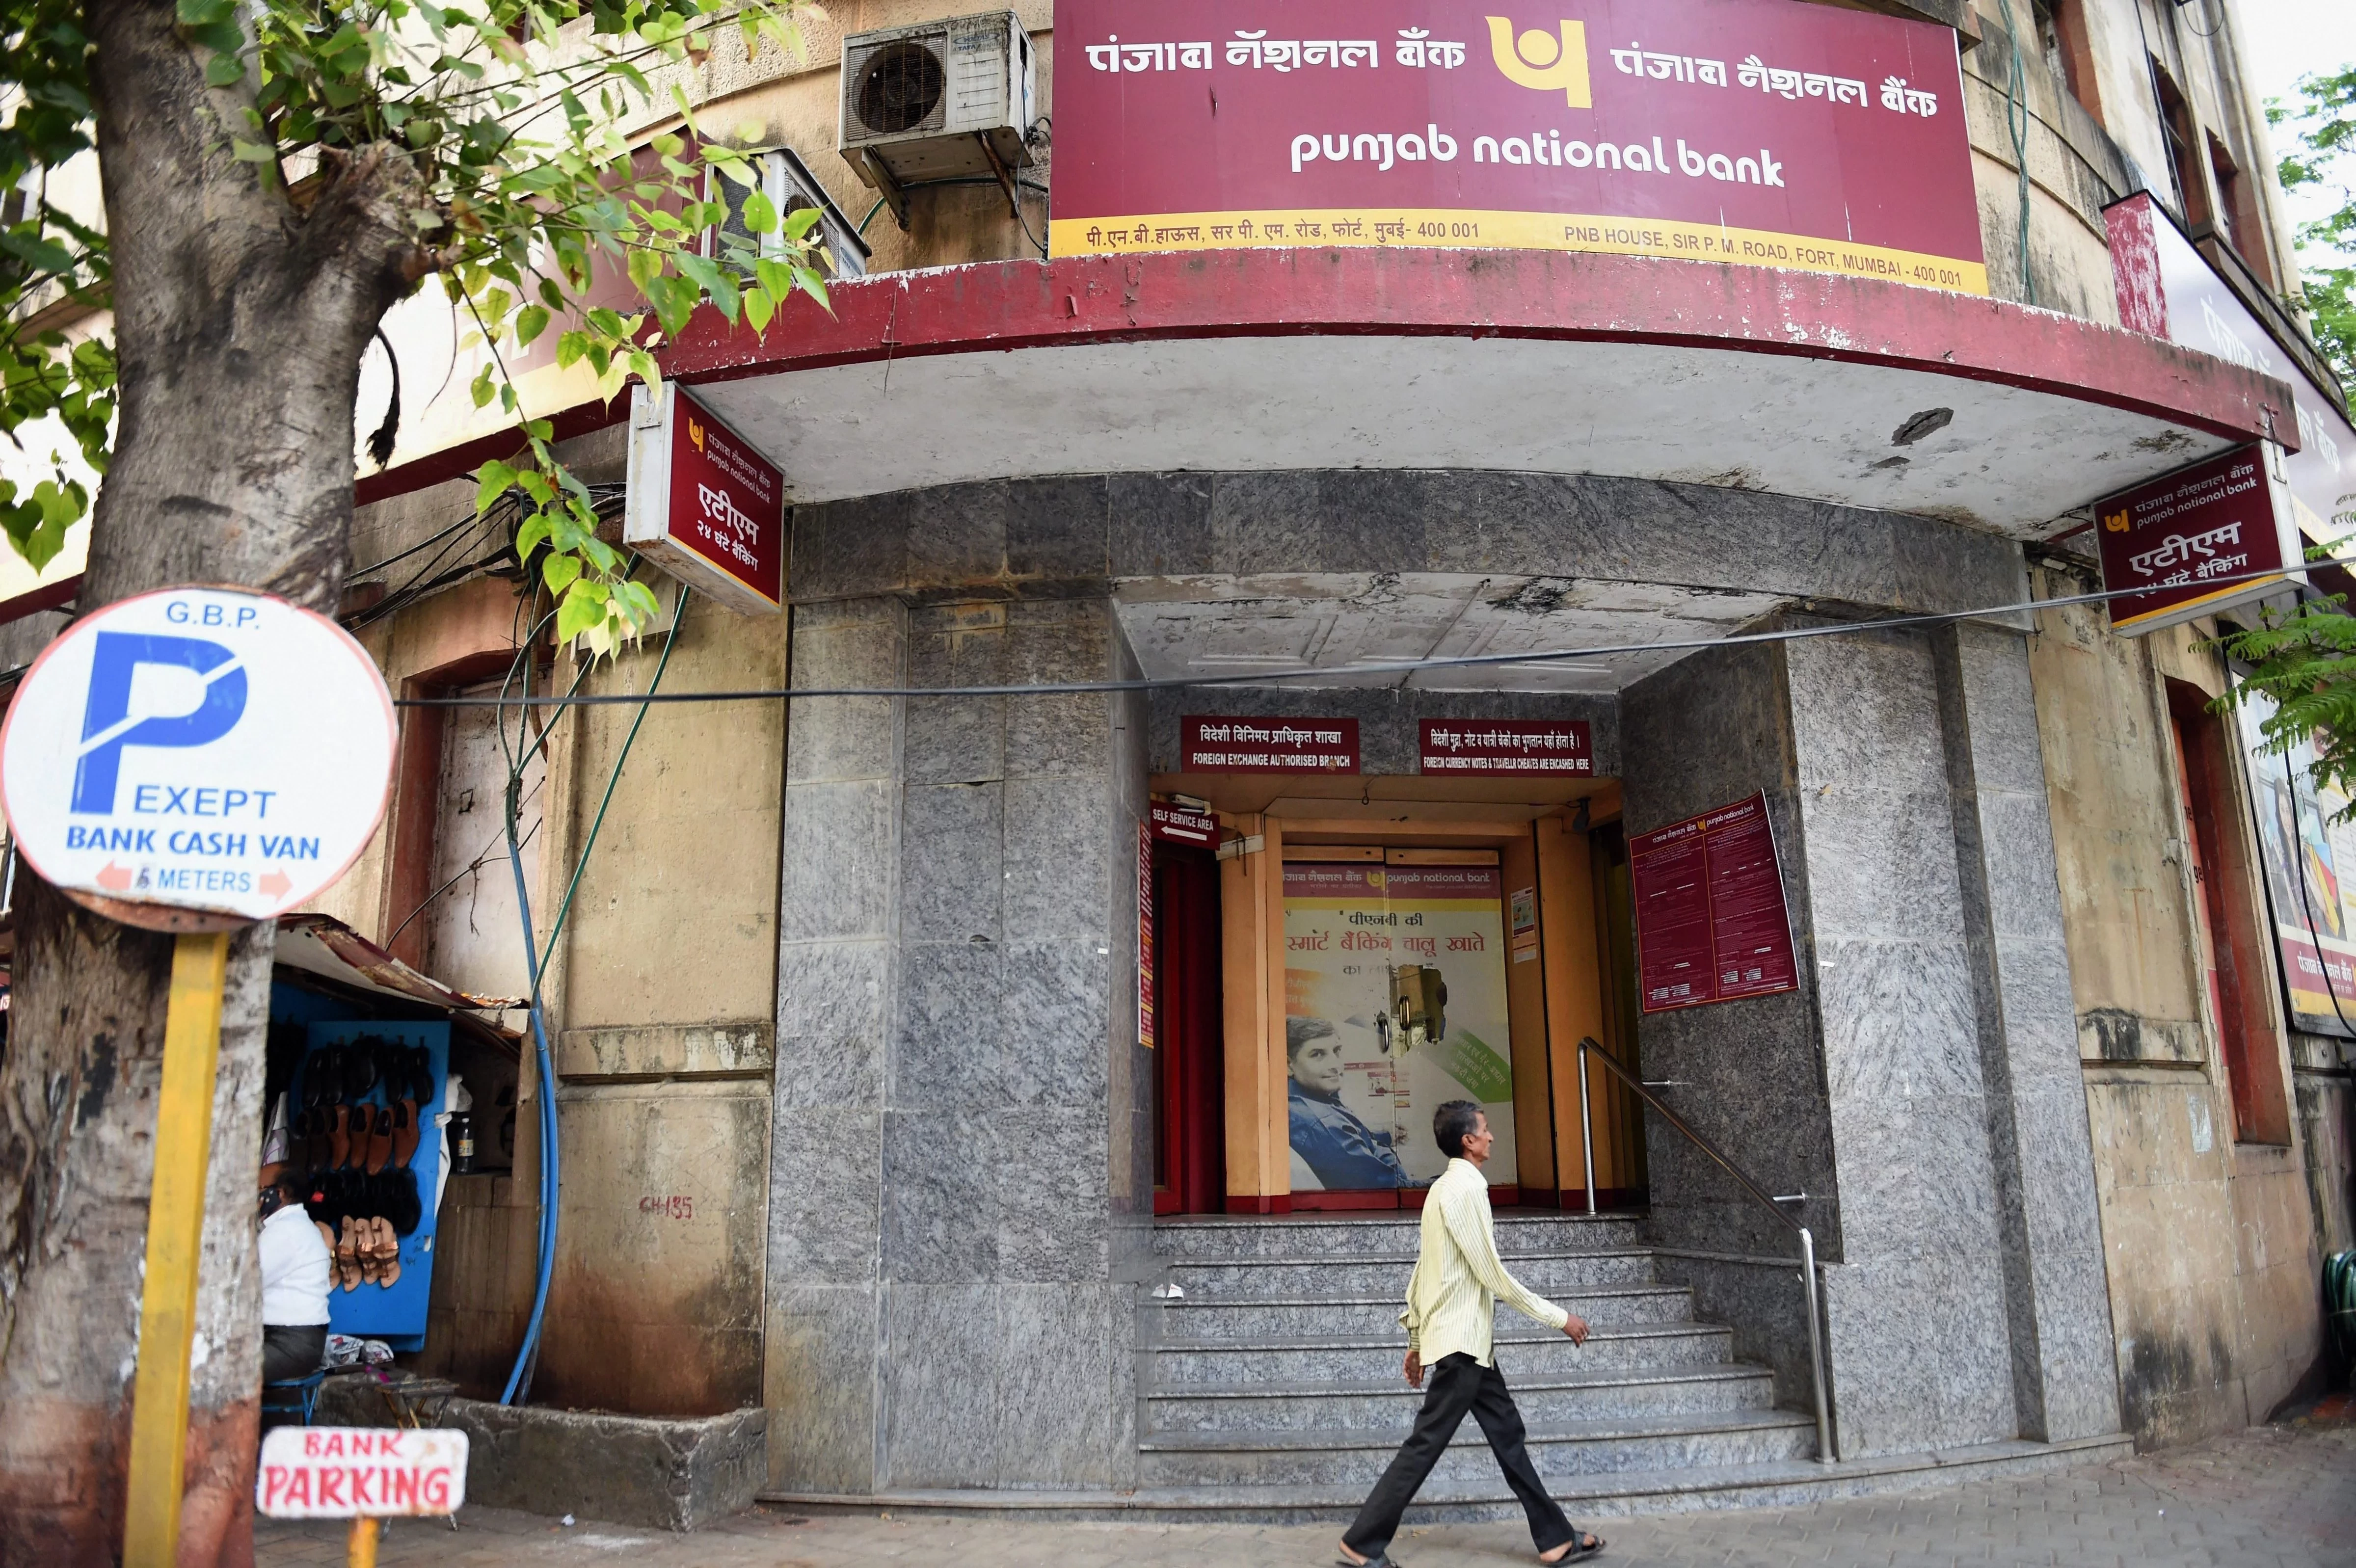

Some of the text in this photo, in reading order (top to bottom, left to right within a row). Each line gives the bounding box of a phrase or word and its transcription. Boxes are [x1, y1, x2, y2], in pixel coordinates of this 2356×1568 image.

[1086, 34, 1212, 72] पंजाब
[1226, 29, 1378, 72] नॅशनल
[1610, 41, 1937, 118] पंजाब नैशनल बैंक
[1291, 124, 1784, 188] punjab national bank
[1210, 225, 1232, 240] सर
[1264, 224, 1289, 240] एम.
[1295, 218, 1326, 239] रोड,
[1332, 218, 1367, 239] फोर्ट,
[1418, 222, 1446, 238] 400
[1452, 223, 1478, 238] 001
[1564, 226, 1600, 242] PNB
[1605, 228, 1668, 249] HOUSE,
[1673, 233, 1700, 250] SIR
[1704, 237, 1717, 252] P.
[1721, 238, 1739, 254] M.
[1743, 241, 1793, 263] ROAD,
[1796, 247, 1839, 270] FORT,
[1843, 254, 1901, 276] MUMBAI
[1914, 265, 1935, 282] 400
[1939, 269, 1961, 287] 001
[708, 433, 730, 458] पंजाब
[707, 450, 770, 504] punjab national bank
[2135, 464, 2254, 513] पंजाब नैशनल बैंक
[698, 482, 759, 545] एटीएम
[2137, 477, 2257, 530] punjab national bank
[697, 520, 758, 571] २४ घंटे बैंकिंग
[2129, 521, 2242, 577] एटीएम
[2195, 553, 2248, 579] बैंकिंग
[166, 601, 261, 630] G.B.P.
[70, 631, 248, 816] P
[1200, 724, 1341, 748] विदेशी विनिमय प्राधिकृत शाखा
[1431, 728, 1448, 746] विदेशी
[1464, 729, 1475, 747] नोट
[1476, 734, 1482, 747] व
[1482, 729, 1497, 747] यात्री
[1498, 729, 1511, 747] चेकों
[1512, 735, 1521, 747] का
[1522, 735, 1542, 753] भुगतान
[1543, 729, 1554, 749] यहाँ
[1555, 730, 1569, 749] होता
[1193, 752, 1350, 767] FOREIGN EXCHANGE AUTHORISED BRANCH
[1423, 756, 1445, 768] FOREIGN
[1446, 757, 1471, 769] CURRENCY
[1472, 757, 1487, 769] NOTES
[1488, 757, 1492, 769] &
[1539, 758, 1549, 770] ARE
[1550, 758, 1574, 770] ENCASHED
[1576, 759, 1589, 770] HERE
[134, 784, 276, 818] EXEPT
[1707, 814, 1724, 827] punjab
[1724, 808, 1743, 820] national
[1743, 803, 1754, 813] bank
[1152, 808, 1214, 831] SELF SERVICE AREA
[66, 825, 321, 860] BANK CASH VAN
[158, 868, 251, 893] METERS
[1387, 873, 1490, 884] punjab national bank
[1349, 911, 1423, 927] पीएनबी की
[1401, 936, 1437, 957] चालू
[1445, 931, 1485, 952] खाते
[2297, 950, 2318, 975] पंजाब
[305, 1431, 403, 1458] BANK
[265, 1465, 451, 1509] PARKING
